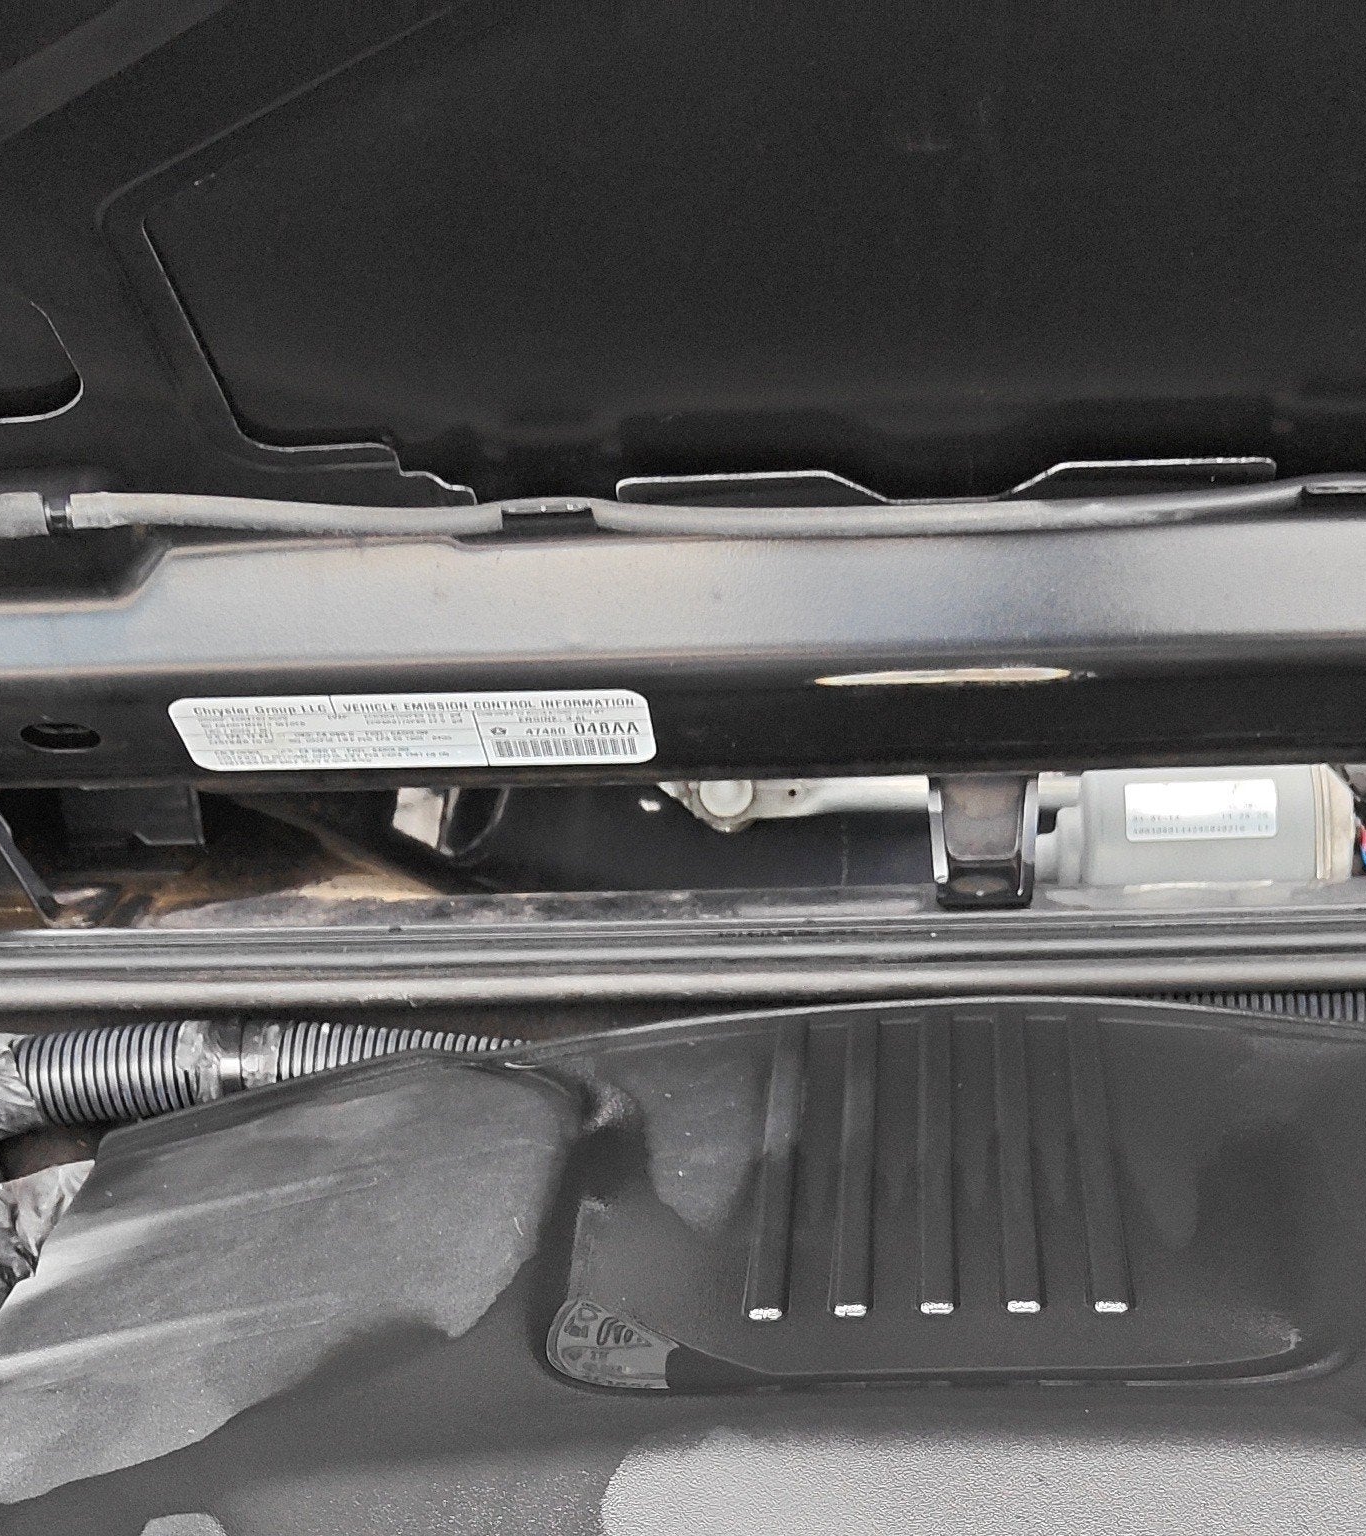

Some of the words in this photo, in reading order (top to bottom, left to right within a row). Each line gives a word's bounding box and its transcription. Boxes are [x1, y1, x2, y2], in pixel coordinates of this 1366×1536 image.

[193, 705, 250, 718] Chrysler
[254, 704, 296, 716] Group
[300, 703, 327, 714] LLC
[342, 702, 398, 713] VEHICLE
[403, 701, 468, 712] EMISSION
[473, 700, 535, 710] CONTROL
[540, 698, 635, 709] INFORMATION
